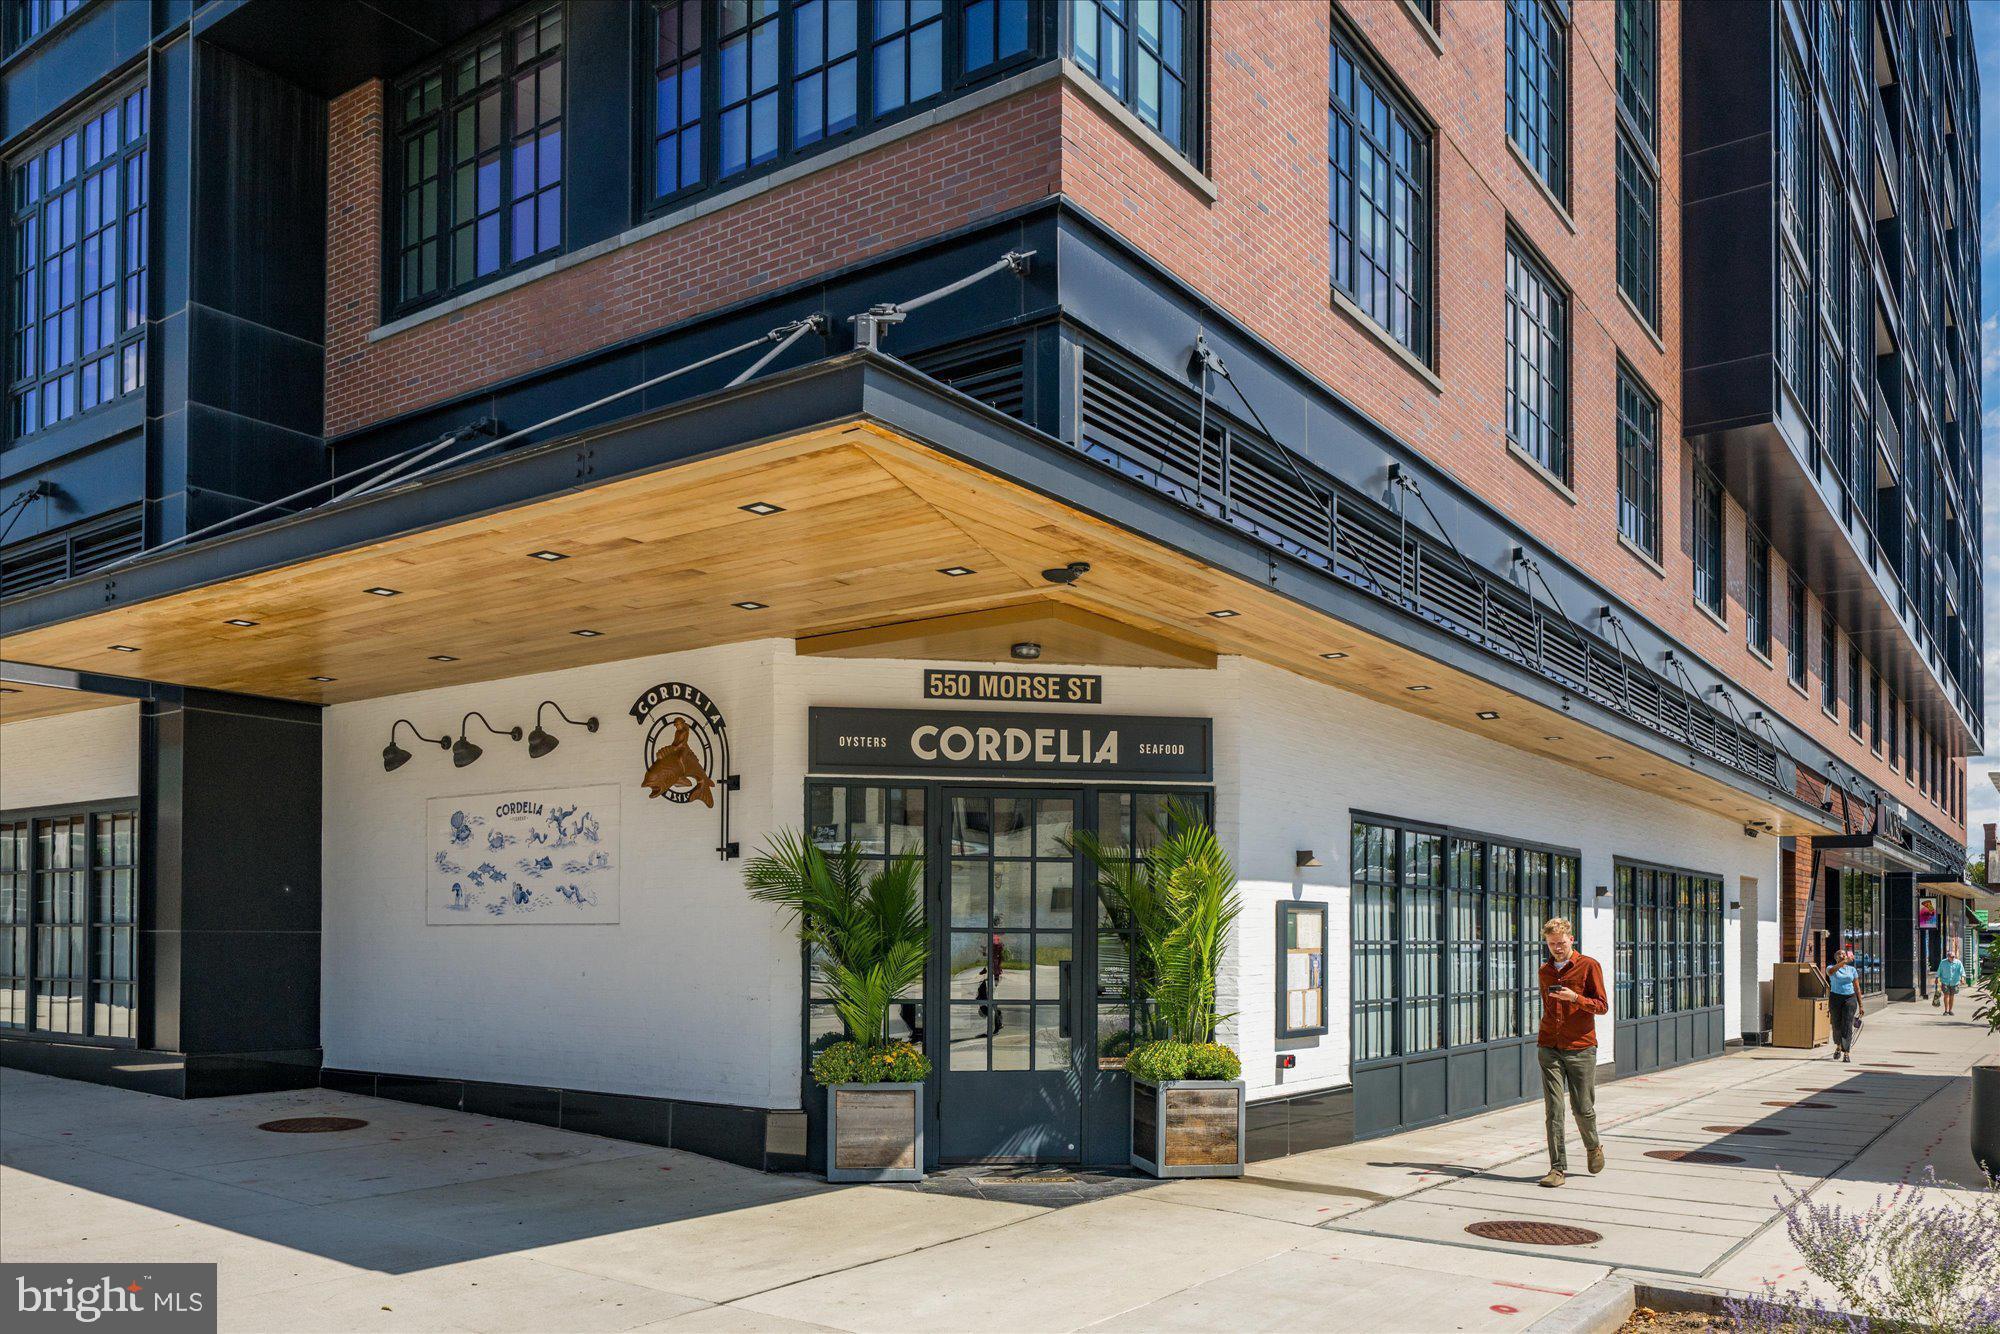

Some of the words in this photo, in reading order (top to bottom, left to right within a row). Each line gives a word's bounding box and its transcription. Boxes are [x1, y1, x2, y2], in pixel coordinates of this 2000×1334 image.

[930, 673, 971, 697] 550
[979, 674, 1060, 699] MORSE
[1068, 677, 1096, 701] ST
[638, 684, 721, 724] CORDELIA
[839, 736, 887, 748] OYSTERS
[910, 725, 1118, 764] CORDELIA
[1139, 743, 1185, 755] SEAFOOD
[496, 801, 543, 818] CORDELIA
